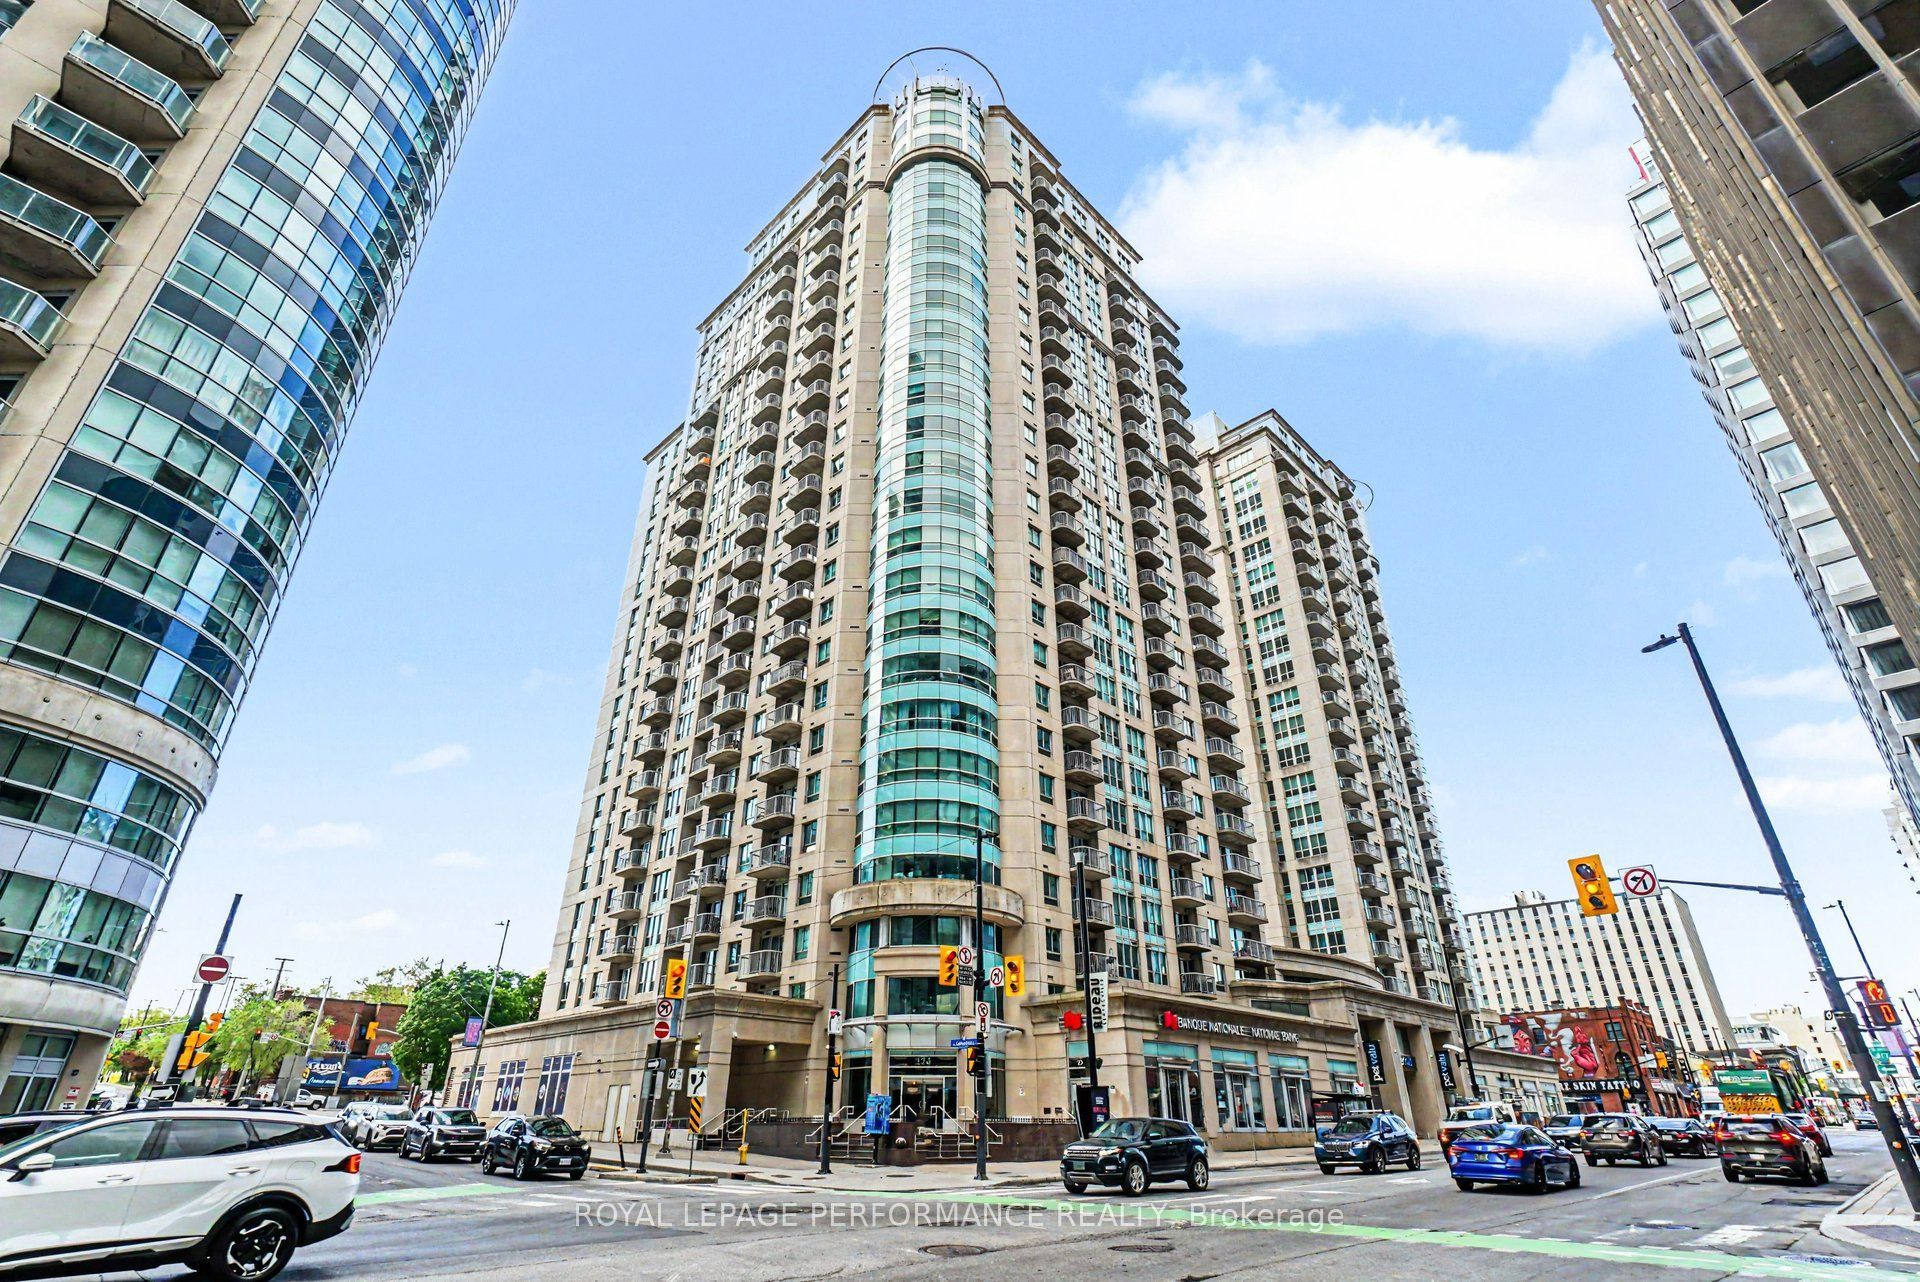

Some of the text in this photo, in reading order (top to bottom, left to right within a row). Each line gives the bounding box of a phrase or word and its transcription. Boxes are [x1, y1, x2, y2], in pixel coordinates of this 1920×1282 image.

[1178, 1017, 1245, 1036] BANQUE NATIONALE
[1367, 1044, 1384, 1082] pet valu
[1438, 1053, 1454, 1087] pet valu
[1572, 1081, 1597, 1091] SKIN
[1600, 1080, 1640, 1091] TATTO
